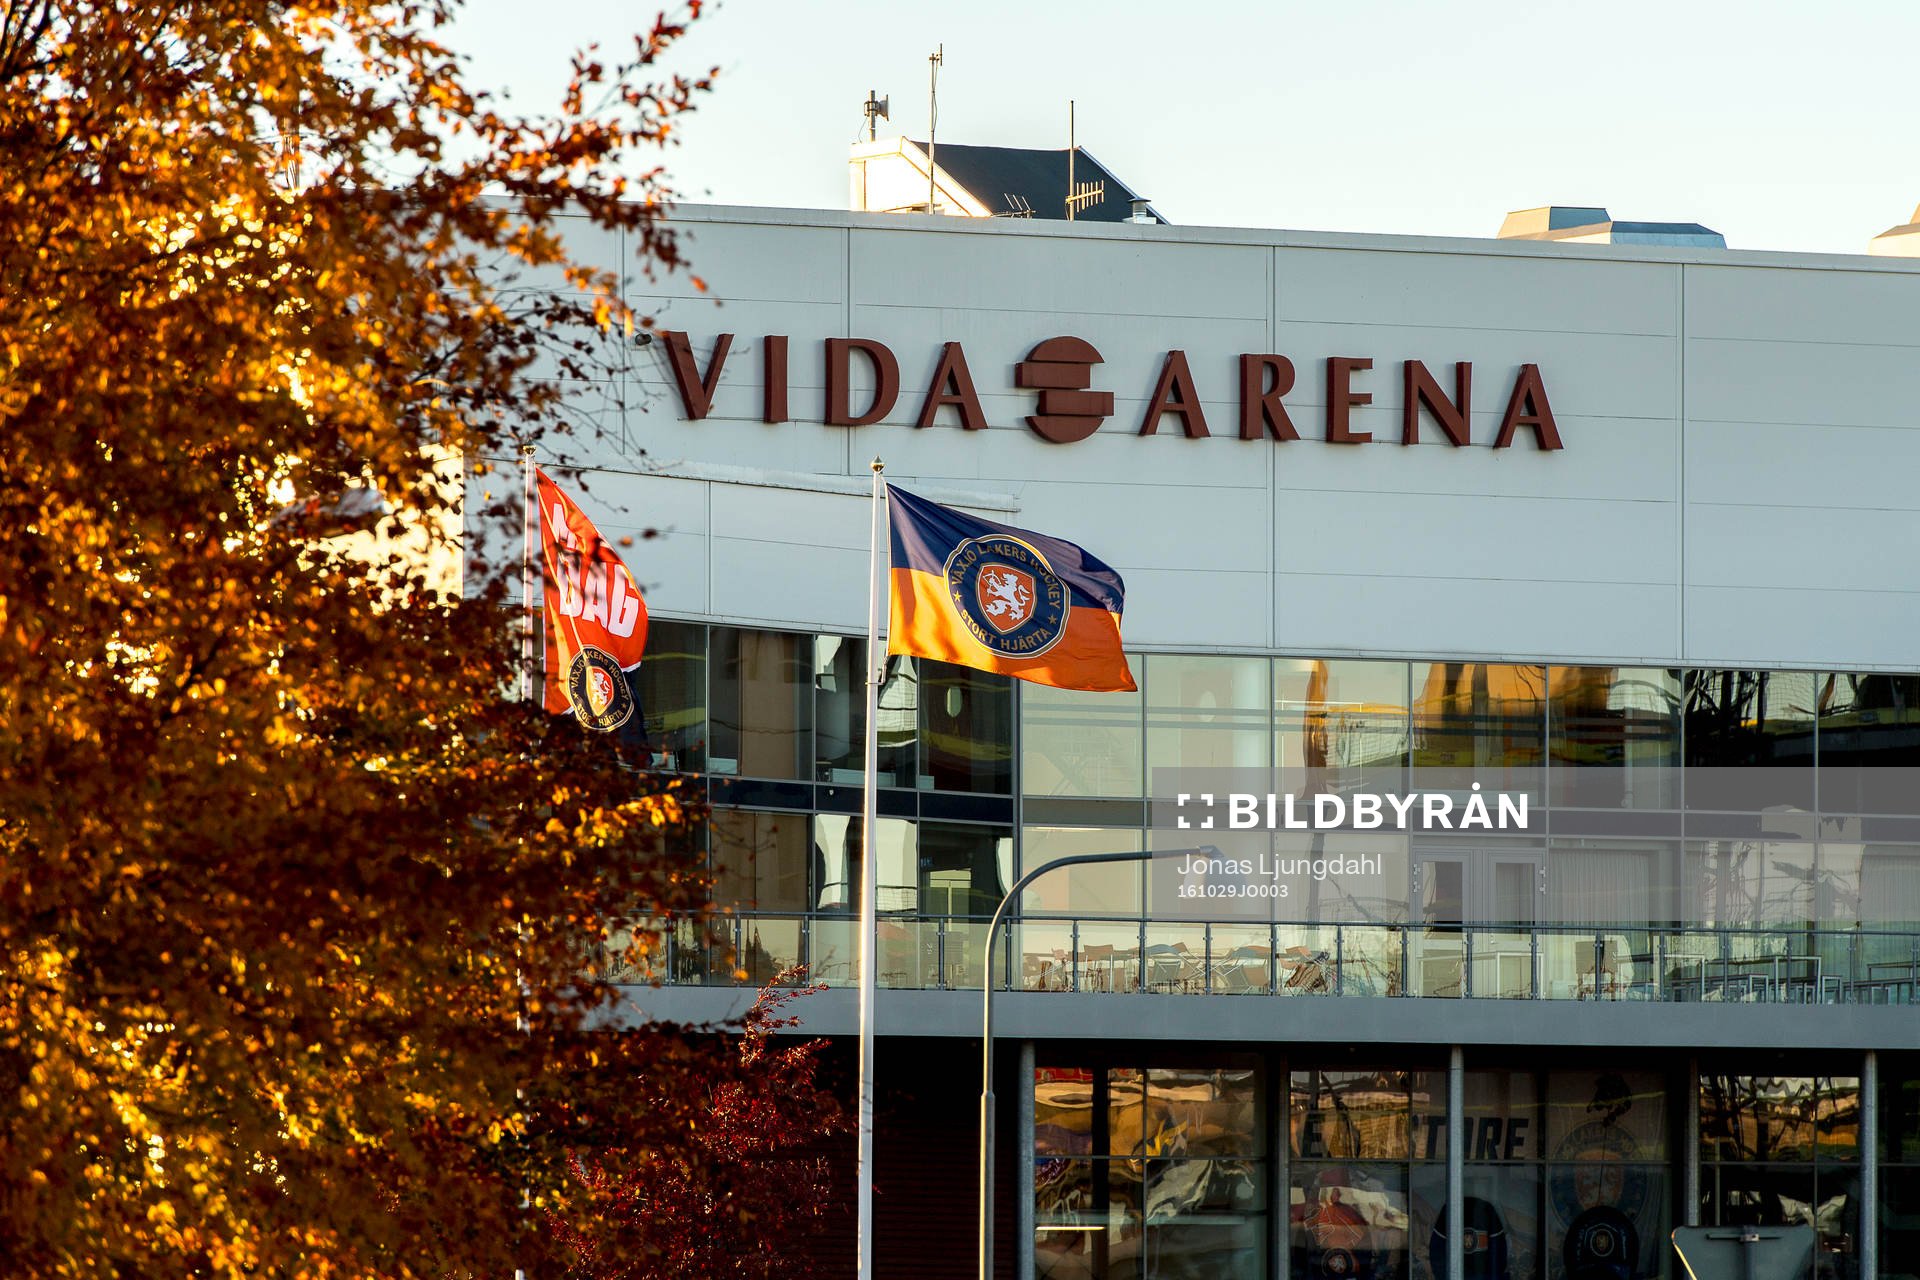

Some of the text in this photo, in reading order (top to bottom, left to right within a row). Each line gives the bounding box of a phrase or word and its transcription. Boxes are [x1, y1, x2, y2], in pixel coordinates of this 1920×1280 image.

[664, 330, 1565, 451] VIDA ARENA
[961, 609, 997, 645] STORT
[1001, 627, 1053, 651] HJÄRTA
